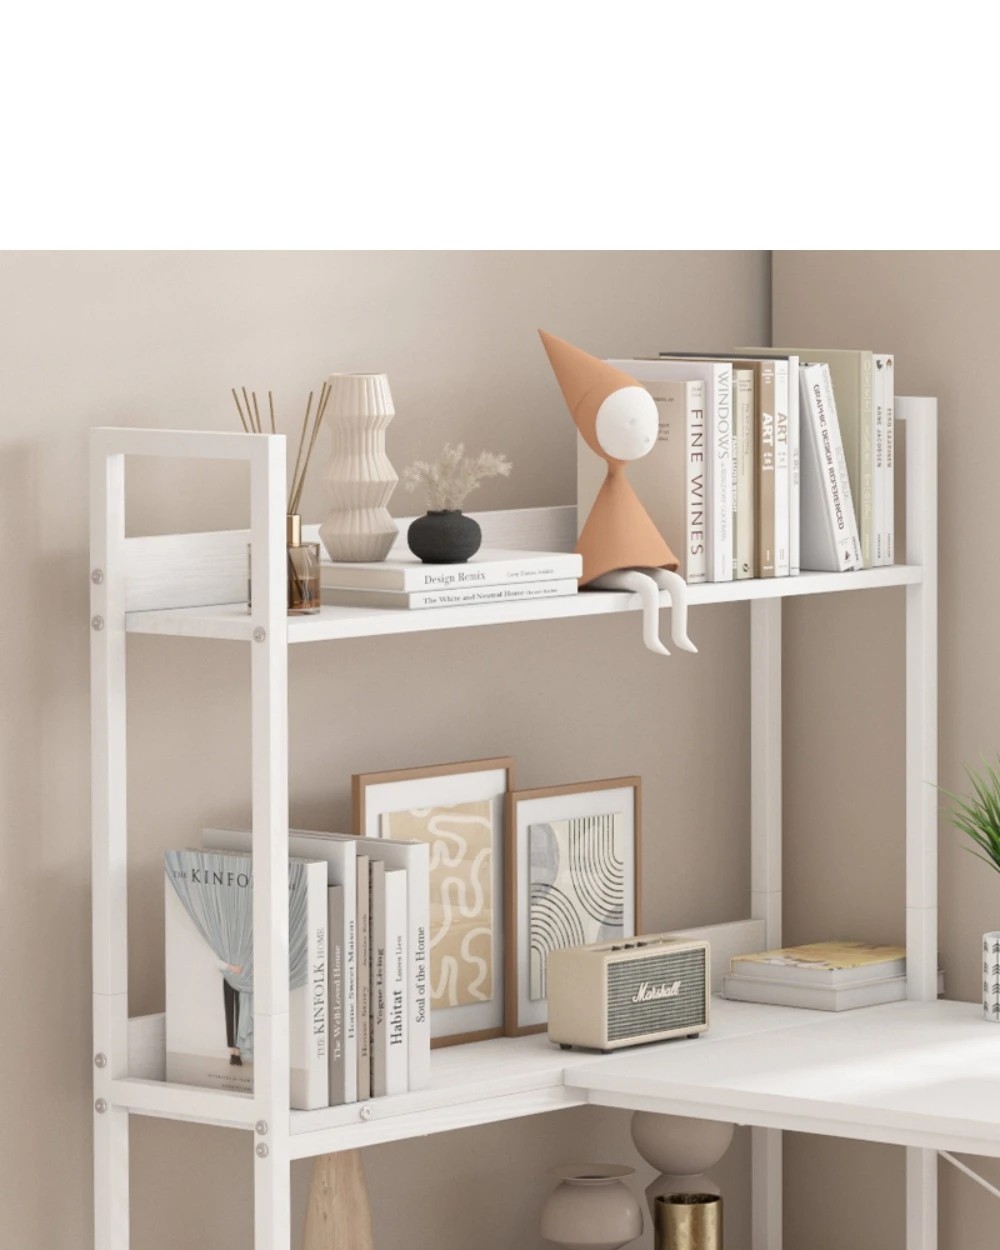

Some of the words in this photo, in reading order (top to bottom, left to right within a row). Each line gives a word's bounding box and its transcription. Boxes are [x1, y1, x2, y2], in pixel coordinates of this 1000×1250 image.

[717, 371, 729, 460] WINDOWS
[762, 411, 774, 446] ART
[777, 412, 787, 444] ART
[690, 409, 704, 462] FINE
[813, 384, 826, 427] GRAPHIC
[822, 429, 833, 465] DESIGN
[828, 466, 845, 530] REFERENCED
[690, 474, 704, 556] WINES
[424, 574, 455, 586] Design
[458, 570, 486, 581] Remix
[191, 868, 254, 888] KINFO
[316, 927, 325, 959] HOME
[415, 926, 425, 961] Home
[377, 947, 385, 986] Living
[416, 964, 425, 982] the
[313, 962, 325, 1035] KINFOLK
[416, 983, 425, 996] of
[632, 980, 681, 1002] Marshall
[377, 988, 385, 1025] Vogue
[390, 989, 402, 1045] Habitat
[416, 998, 425, 1024] Soul
[316, 1039, 325, 1058] THE
[333, 1040, 341, 1061] The
